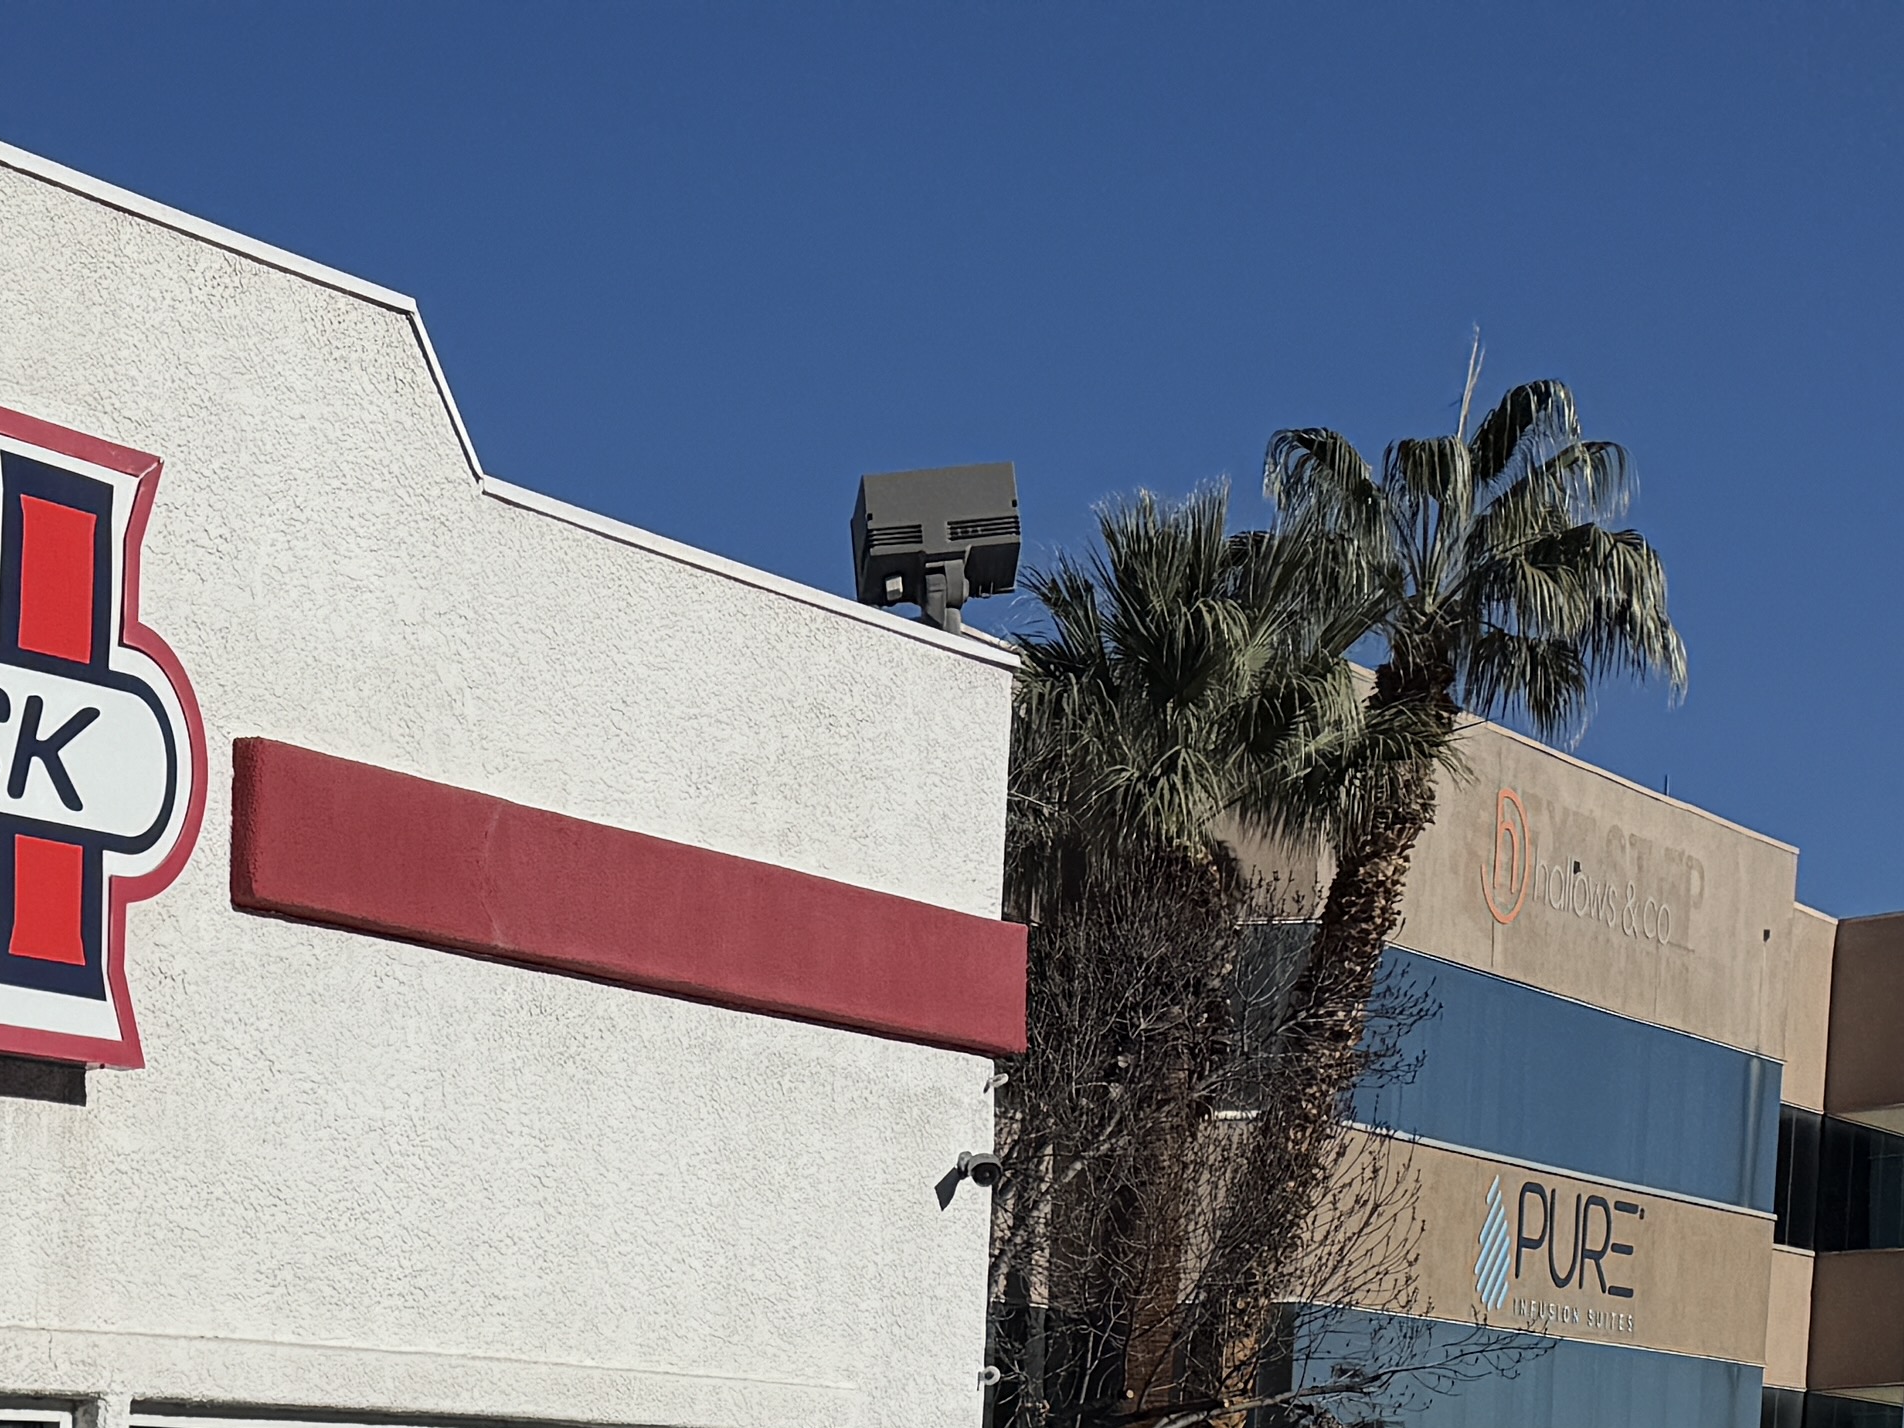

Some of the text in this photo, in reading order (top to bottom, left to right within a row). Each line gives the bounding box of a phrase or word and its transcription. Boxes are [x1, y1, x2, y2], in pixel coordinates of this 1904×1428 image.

[1514, 1181, 1639, 1299] PURE
[1512, 1296, 1634, 1333] INFUSION SUITES
